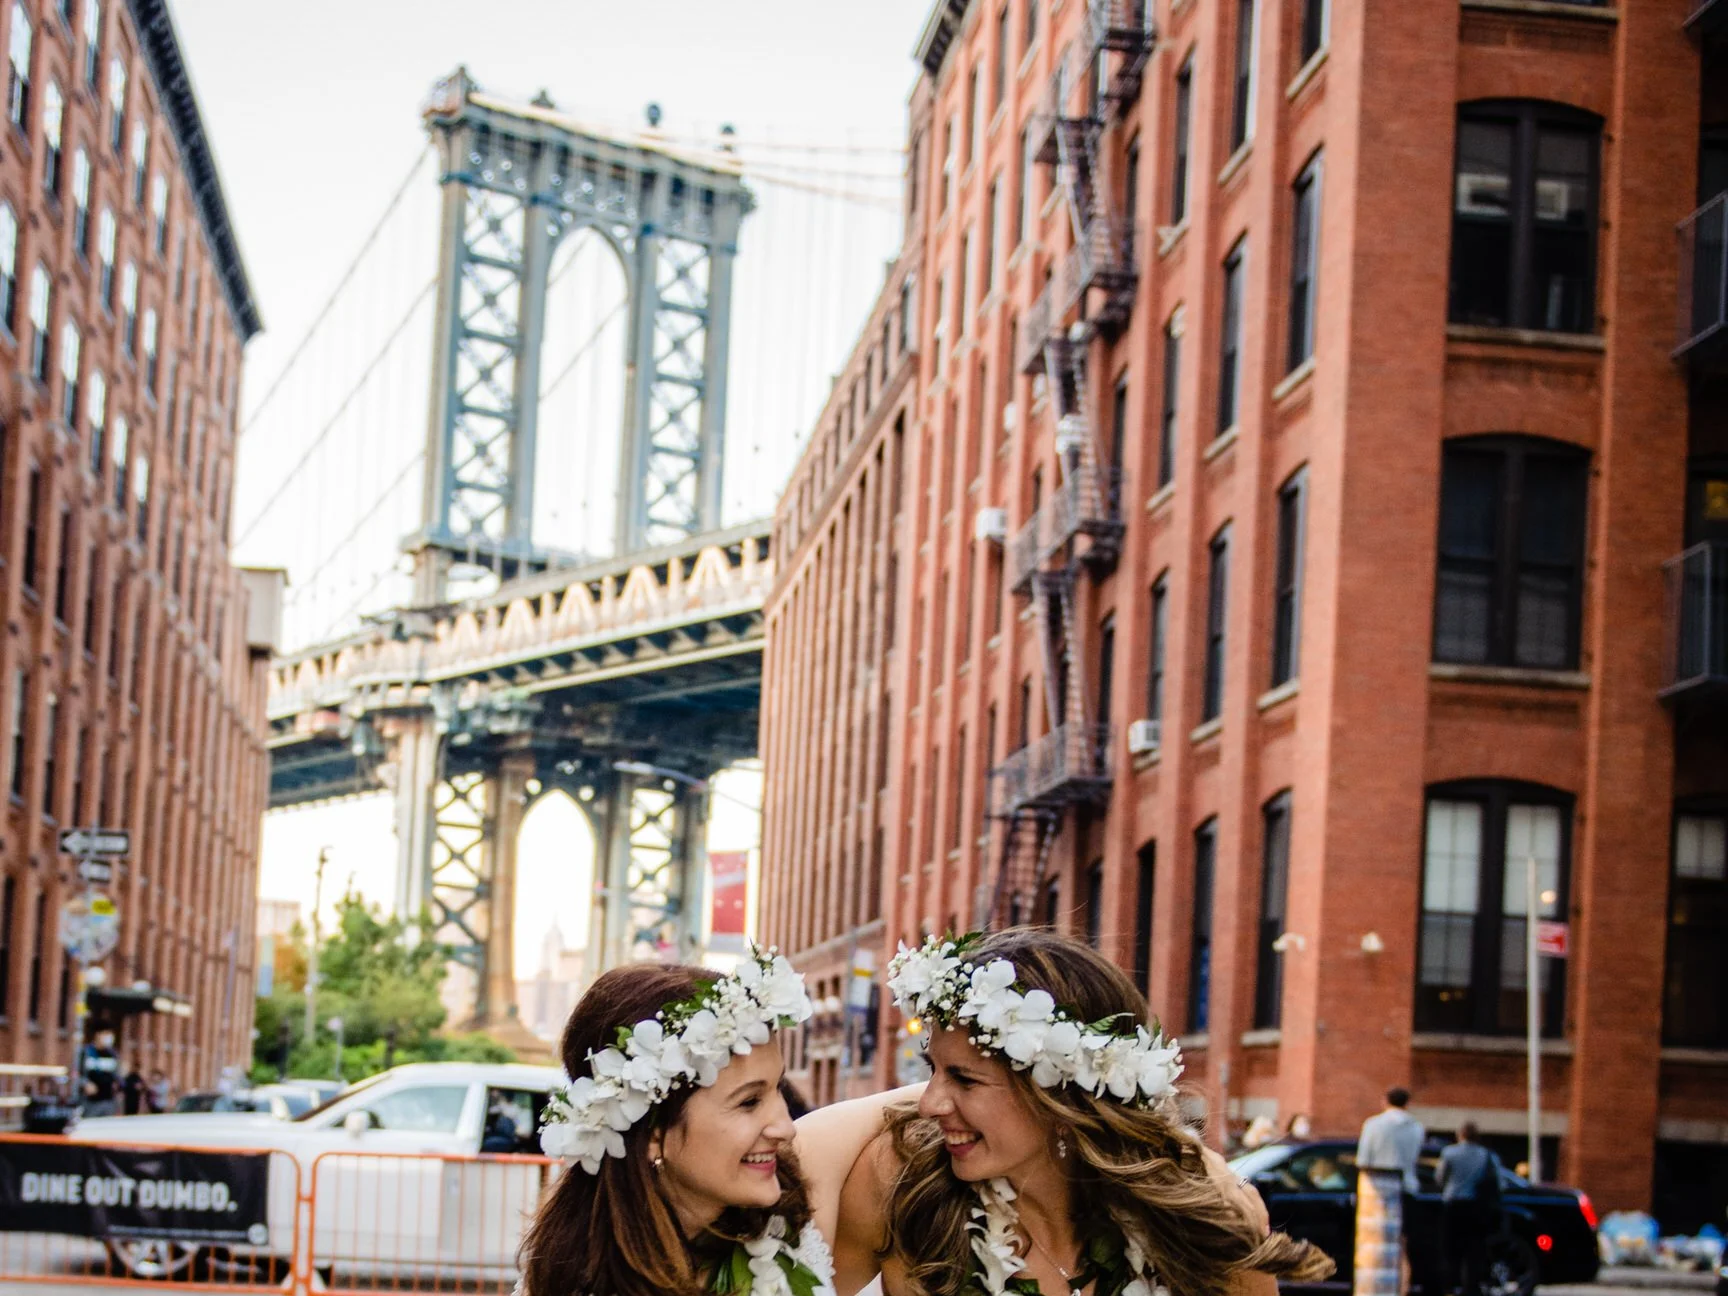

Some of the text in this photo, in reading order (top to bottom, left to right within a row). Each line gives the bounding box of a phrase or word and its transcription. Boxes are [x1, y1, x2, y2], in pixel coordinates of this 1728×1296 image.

[21, 1172, 237, 1212] DINE OUT DUMBO.
